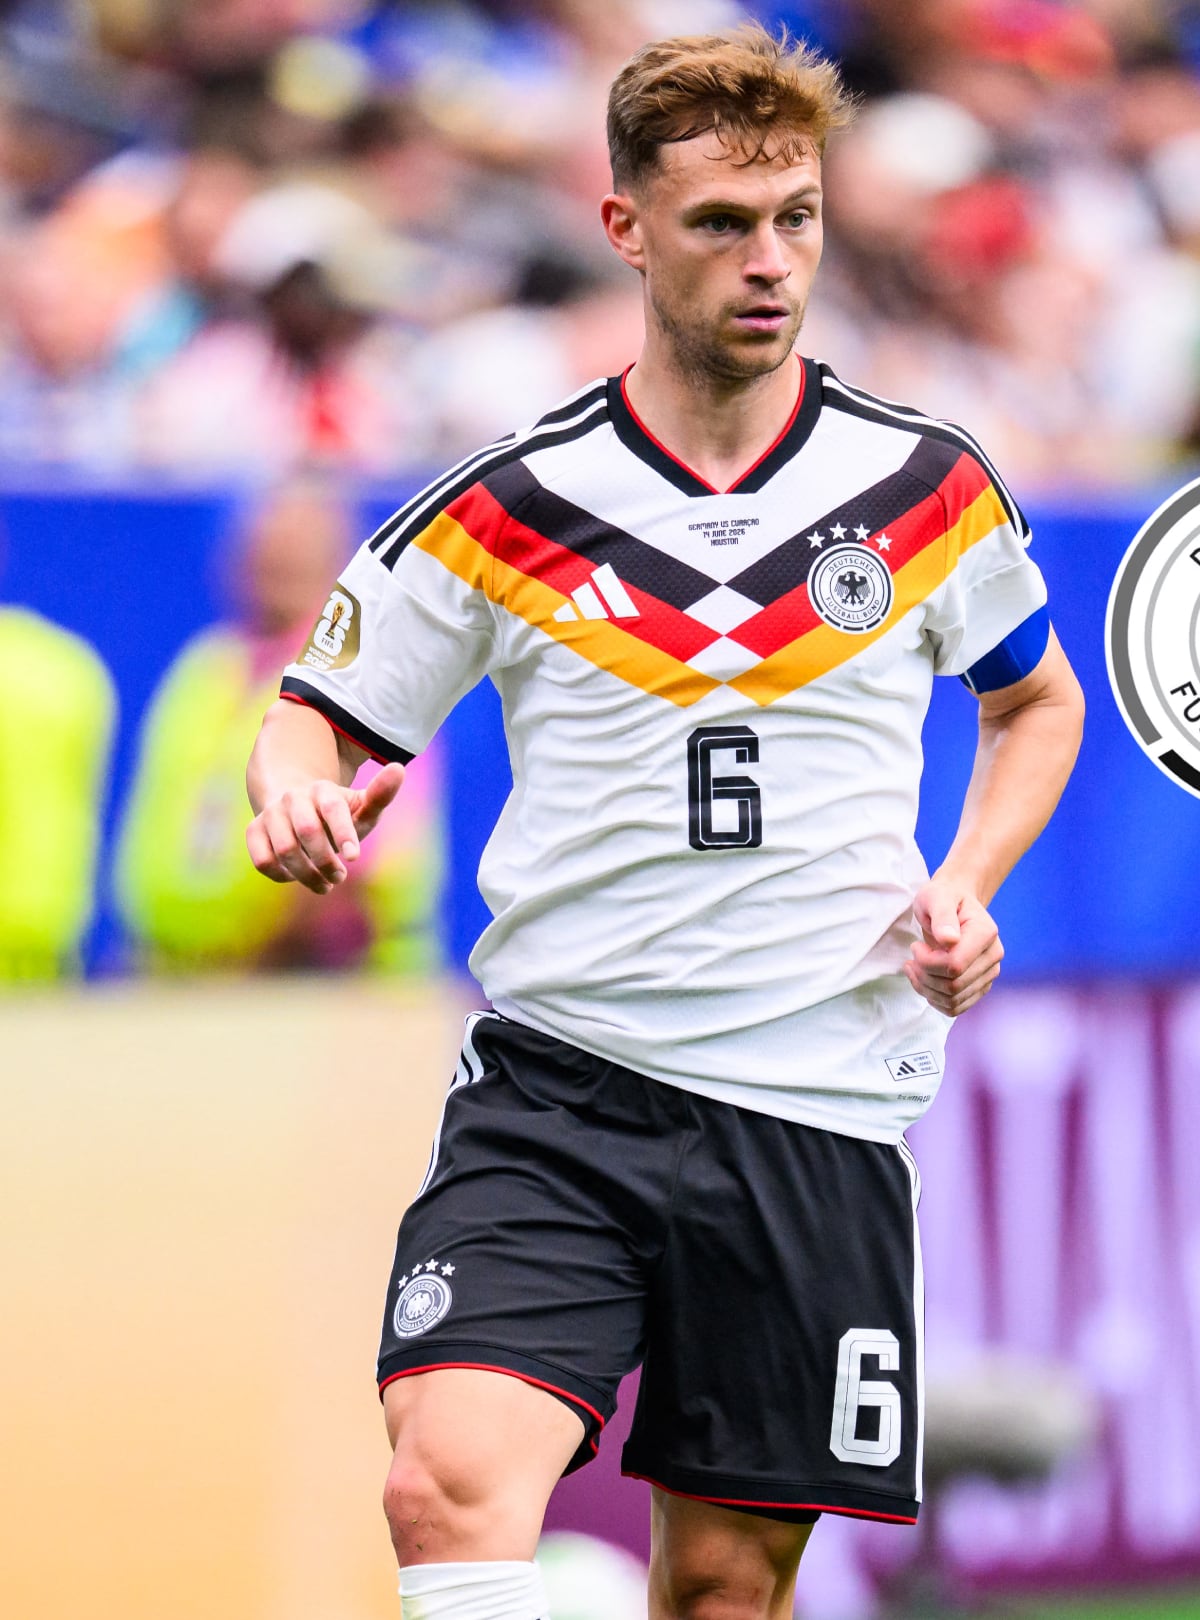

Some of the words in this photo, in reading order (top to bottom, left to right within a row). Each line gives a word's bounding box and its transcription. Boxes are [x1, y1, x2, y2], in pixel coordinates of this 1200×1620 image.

[688, 521, 718, 531] GERMANY
[712, 529, 727, 537] JUNE
[728, 528, 746, 536] 2026
[710, 537, 739, 546] HOUSTON
[828, 557, 875, 573] DEUTSCHER
[687, 725, 763, 851] 6
[829, 1327, 902, 1467] 6
